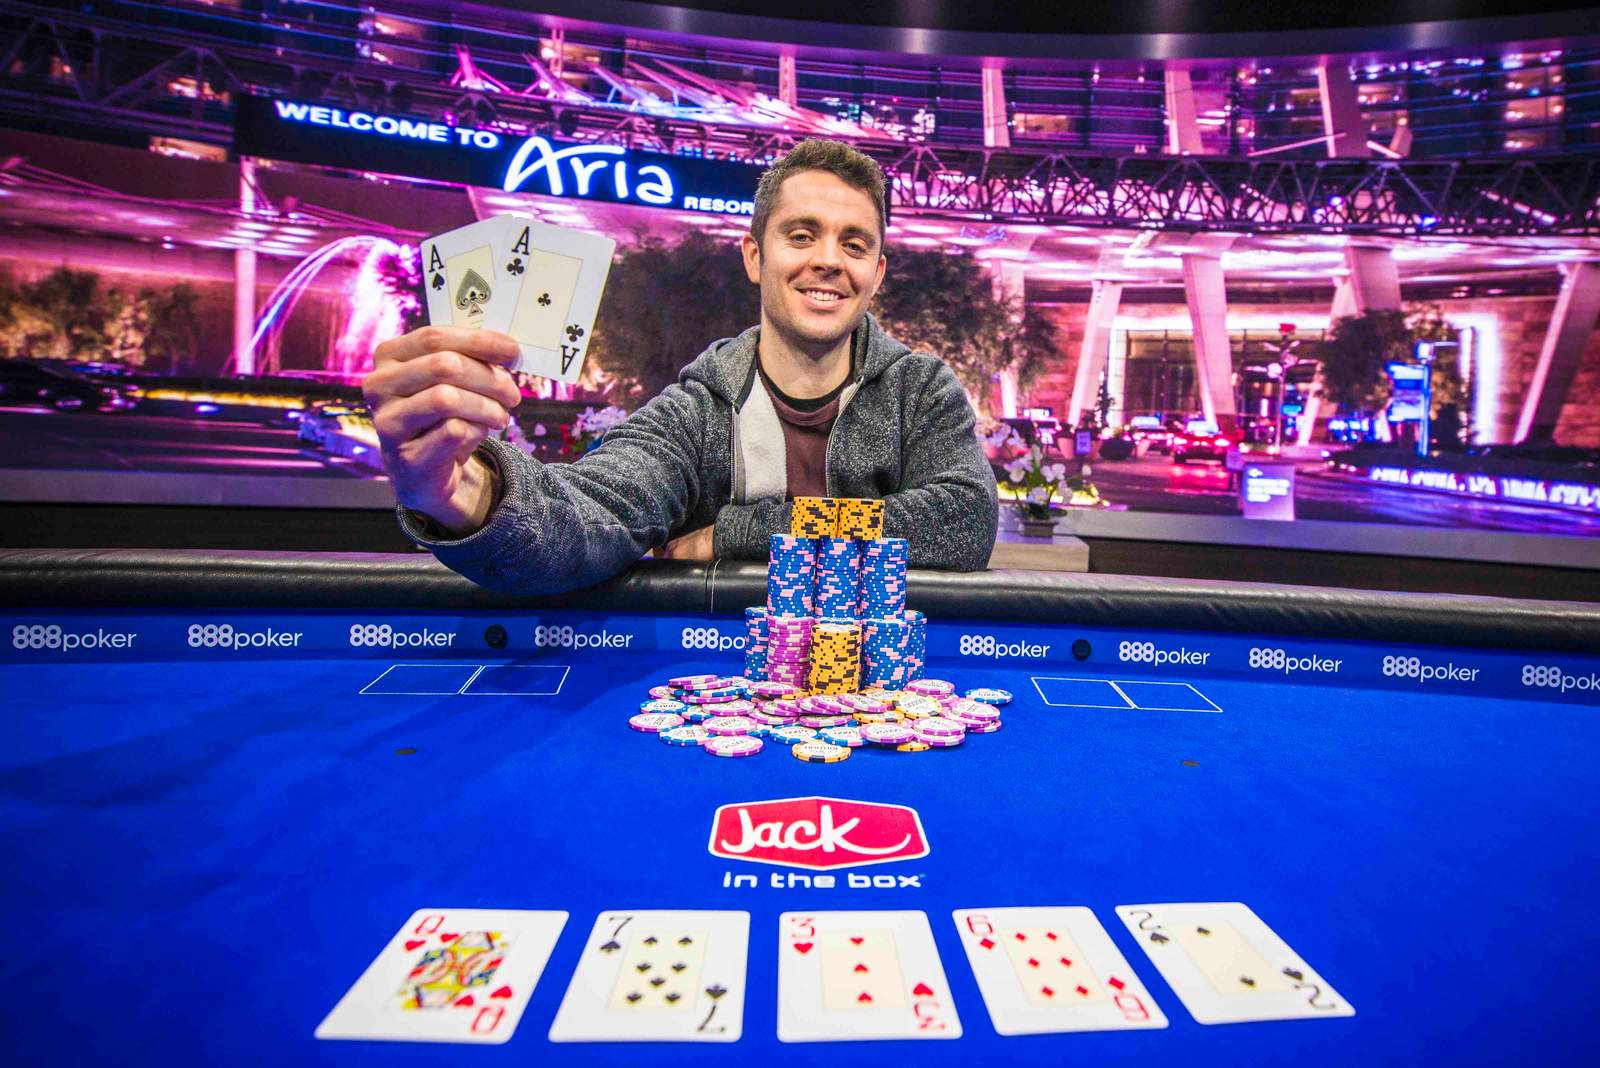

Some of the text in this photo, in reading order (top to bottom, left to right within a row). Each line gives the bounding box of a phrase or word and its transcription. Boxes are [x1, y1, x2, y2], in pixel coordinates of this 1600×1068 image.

[275, 101, 499, 149] WELCOME TO
[504, 136, 675, 204] Aria
[511, 226, 530, 255] A
[428, 244, 444, 272] A
[12, 624, 137, 651] 888poker
[187, 623, 303, 650] 888poker
[349, 623, 456, 649] 888poker
[534, 625, 633, 650] 888poker
[959, 634, 1050, 659] 888poker
[1119, 641, 1210, 666] 888poker
[1249, 647, 1342, 674] 888poker
[1382, 655, 1480, 683] 888poker
[720, 804, 912, 856] Jack
[722, 871, 922, 888] in the box
[608, 916, 633, 936] 7
[791, 917, 816, 940] 3
